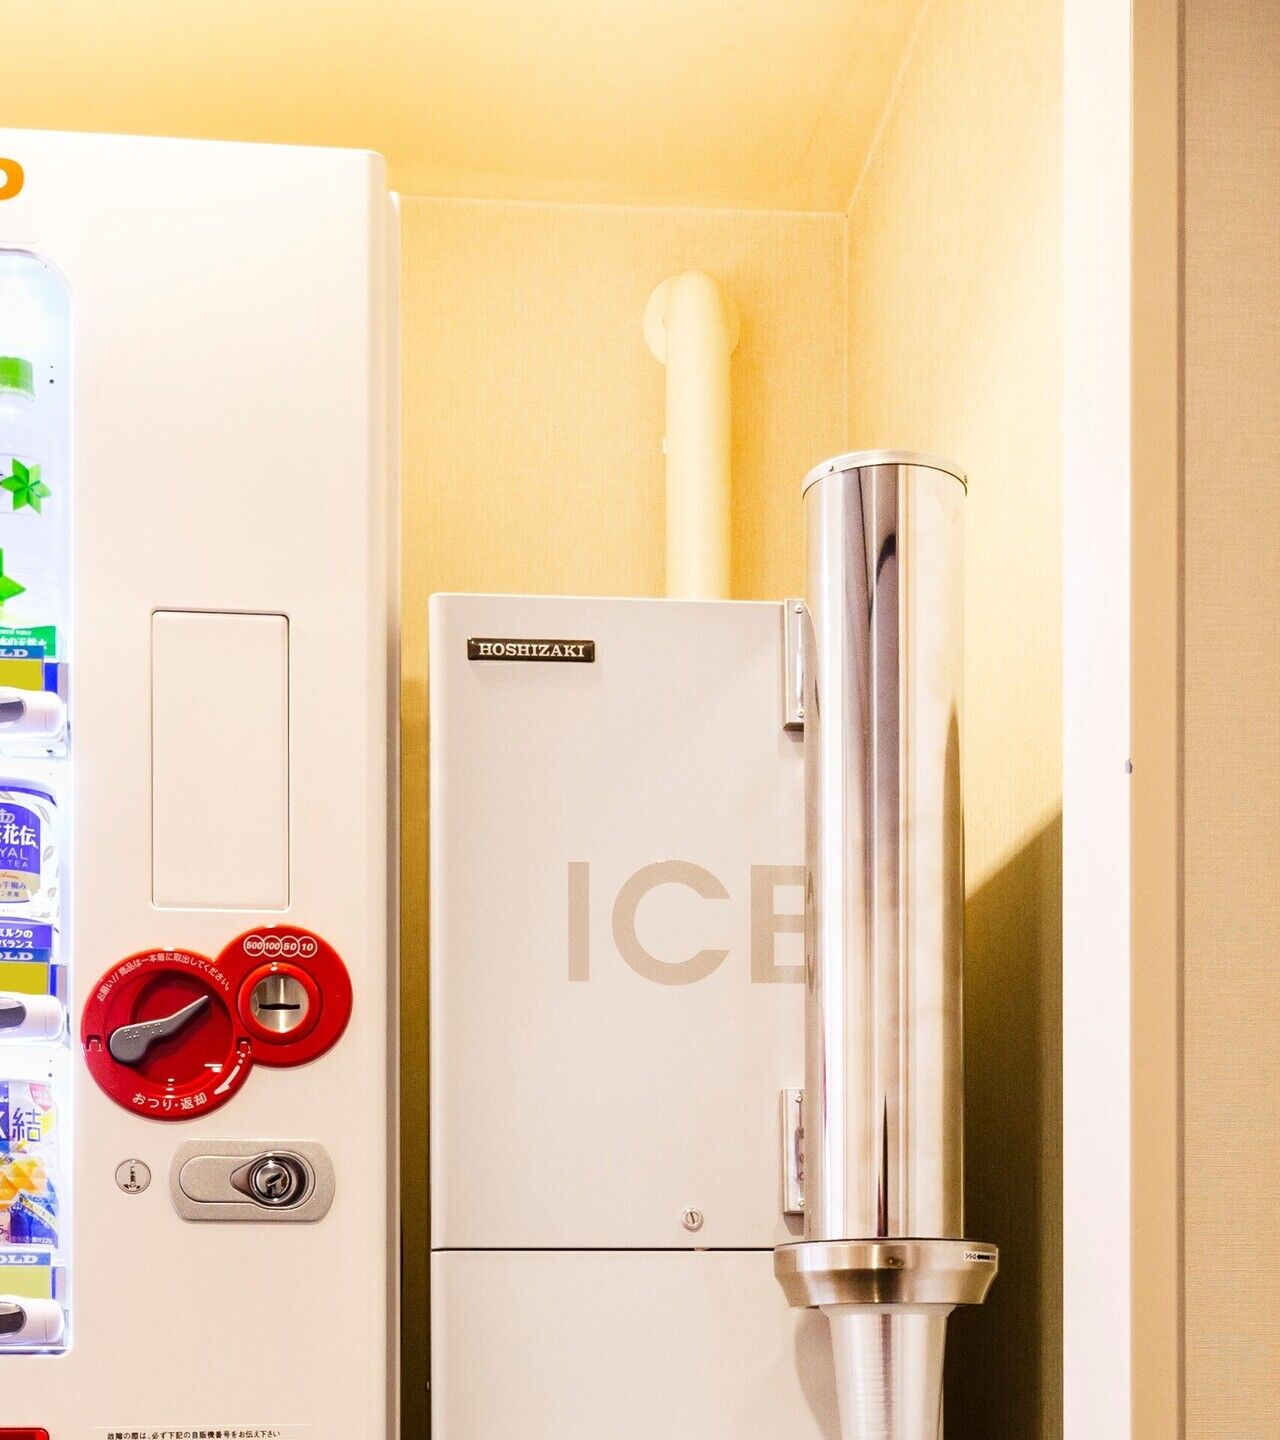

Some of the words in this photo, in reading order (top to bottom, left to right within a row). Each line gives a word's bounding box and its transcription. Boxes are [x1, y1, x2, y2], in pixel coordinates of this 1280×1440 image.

[478, 642, 585, 658] HOSHIZAKI
[6, 859, 29, 868] TEA
[567, 859, 807, 986] ICE
[246, 941, 263, 950] 500
[264, 942, 281, 951] 100
[283, 942, 297, 951] 50
[301, 943, 314, 951] 10
[132, 1092, 208, 1111] おつり・返却
